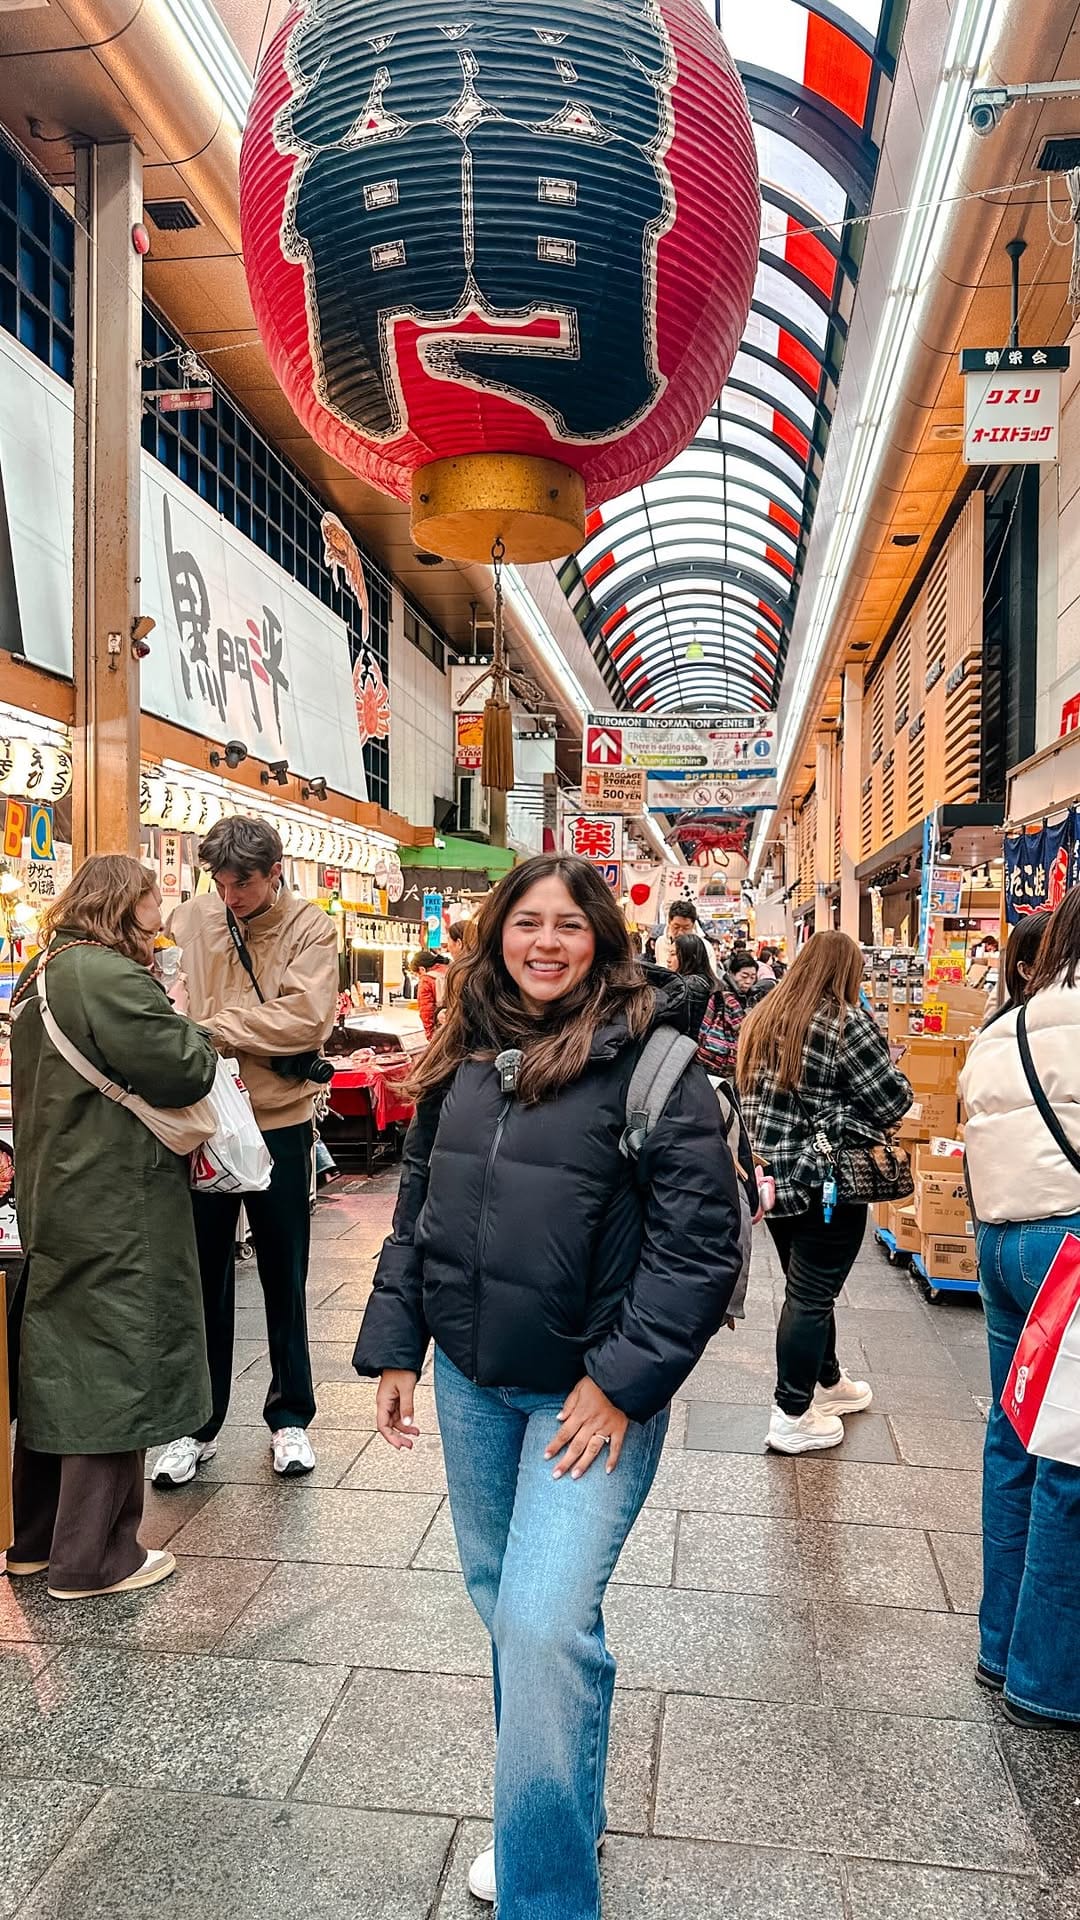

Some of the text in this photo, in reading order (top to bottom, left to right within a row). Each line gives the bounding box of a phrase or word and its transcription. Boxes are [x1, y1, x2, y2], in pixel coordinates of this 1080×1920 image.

[985, 389, 1041, 404] クスリ
[972, 426, 1054, 443] オーエスドラッグ
[593, 717, 749, 728] KUROMON INFORMATION CENTER
[628, 732, 651, 741] FREE
[653, 732, 673, 741] REST
[658, 744, 680, 752] eating
[639, 757, 668, 765] Change
[670, 757, 702, 765] machine
[27, 748, 43, 788] えび
[51, 754, 69, 795] まぐろ
[603, 771, 642, 780] BAGGAGE
[602, 789, 624, 799] 500
[574, 816, 614, 856] 薬
[165, 838, 176, 867] 海鮮丼
[27, 862, 53, 879] サザエ
[668, 871, 686, 887] 活
[1010, 864, 1046, 897] たこ焼
